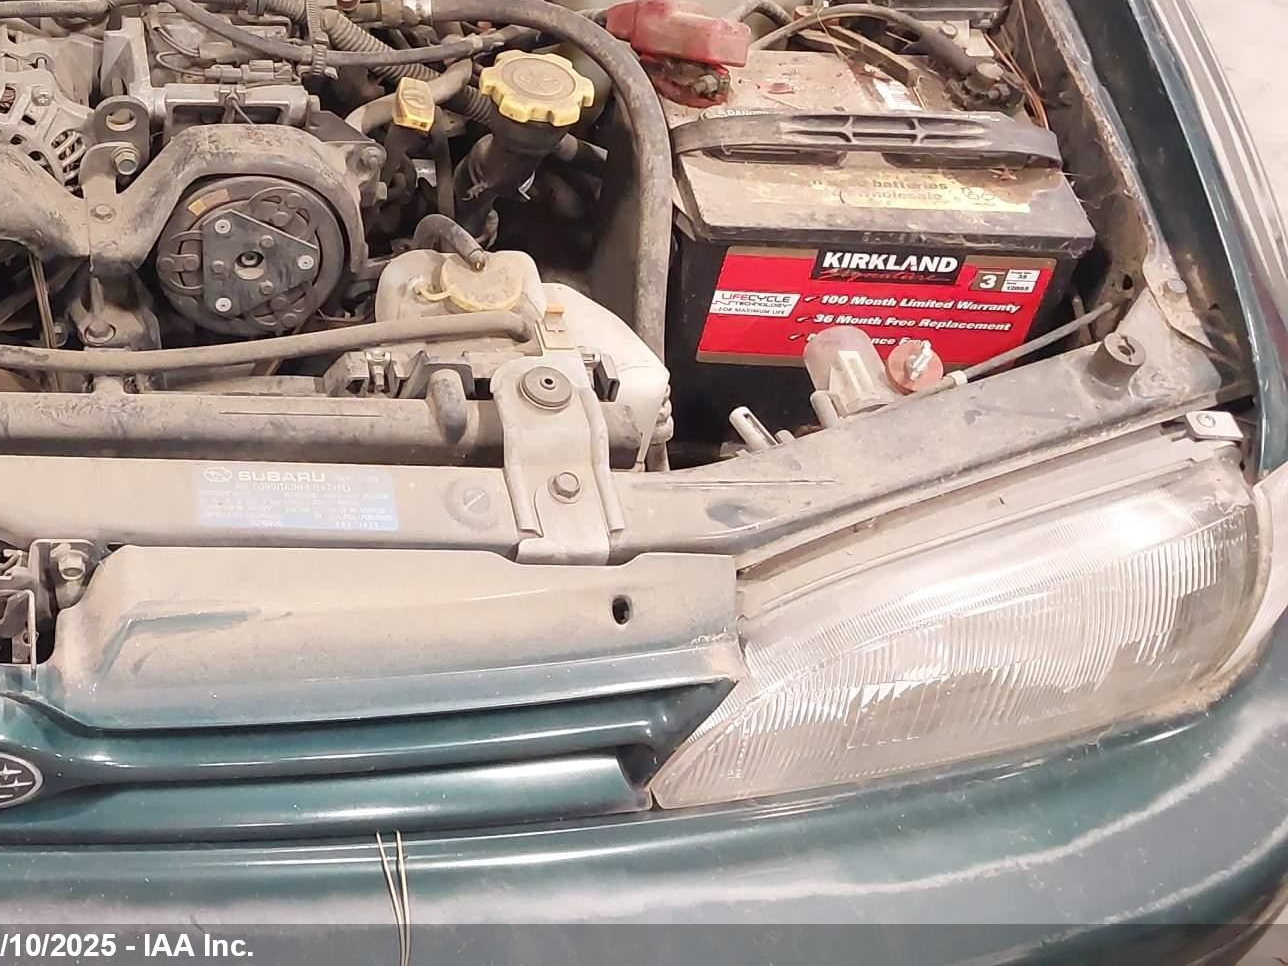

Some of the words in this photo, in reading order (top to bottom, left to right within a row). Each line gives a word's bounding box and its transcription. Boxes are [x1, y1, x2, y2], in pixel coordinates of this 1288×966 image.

[822, 251, 958, 273] KIRKLAND
[979, 274, 997, 289] 3
[721, 292, 792, 303] LIFECYCLE
[821, 295, 849, 305] 100
[850, 296, 897, 307] Month
[899, 298, 954, 309] Limited
[956, 300, 1021, 314] Warranty
[813, 313, 835, 324] 36
[836, 314, 883, 325] Month
[884, 317, 916, 327] Free
[918, 318, 1012, 330] Replacement
[238, 470, 326, 483] SUBARU
